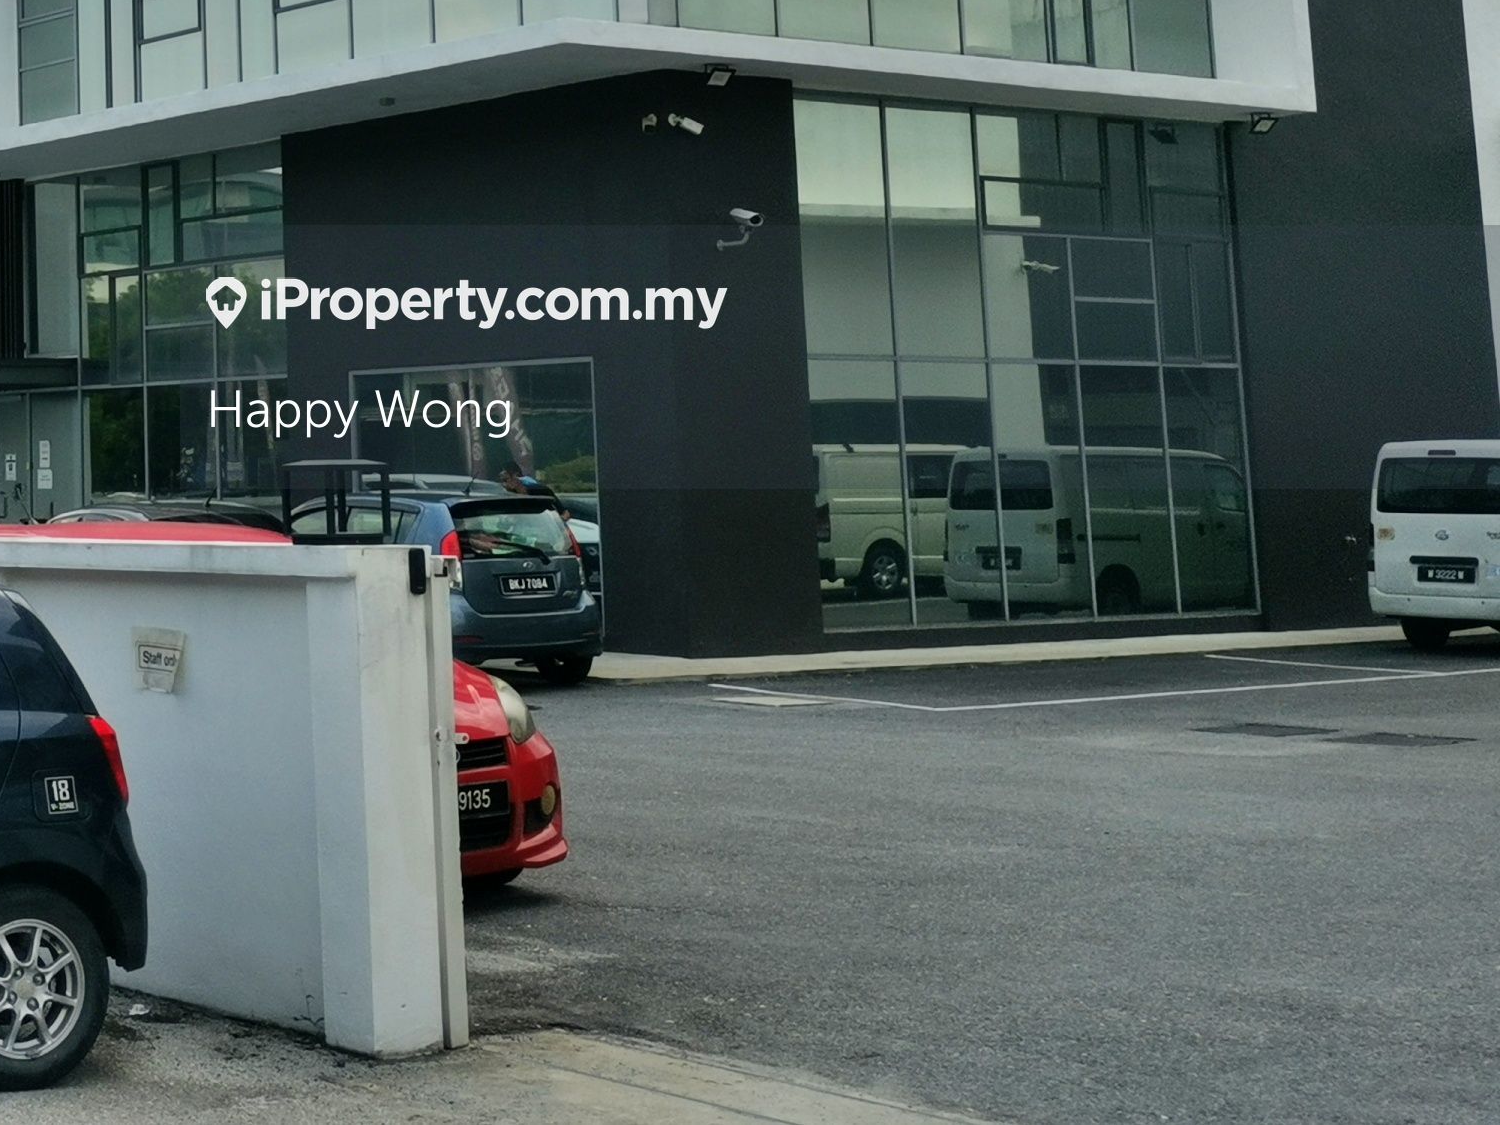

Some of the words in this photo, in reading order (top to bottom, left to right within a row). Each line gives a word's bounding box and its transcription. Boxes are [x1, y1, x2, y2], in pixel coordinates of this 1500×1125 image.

[142, 650, 162, 665] Staff
[51, 779, 70, 802] 18
[458, 788, 491, 811] 9135
